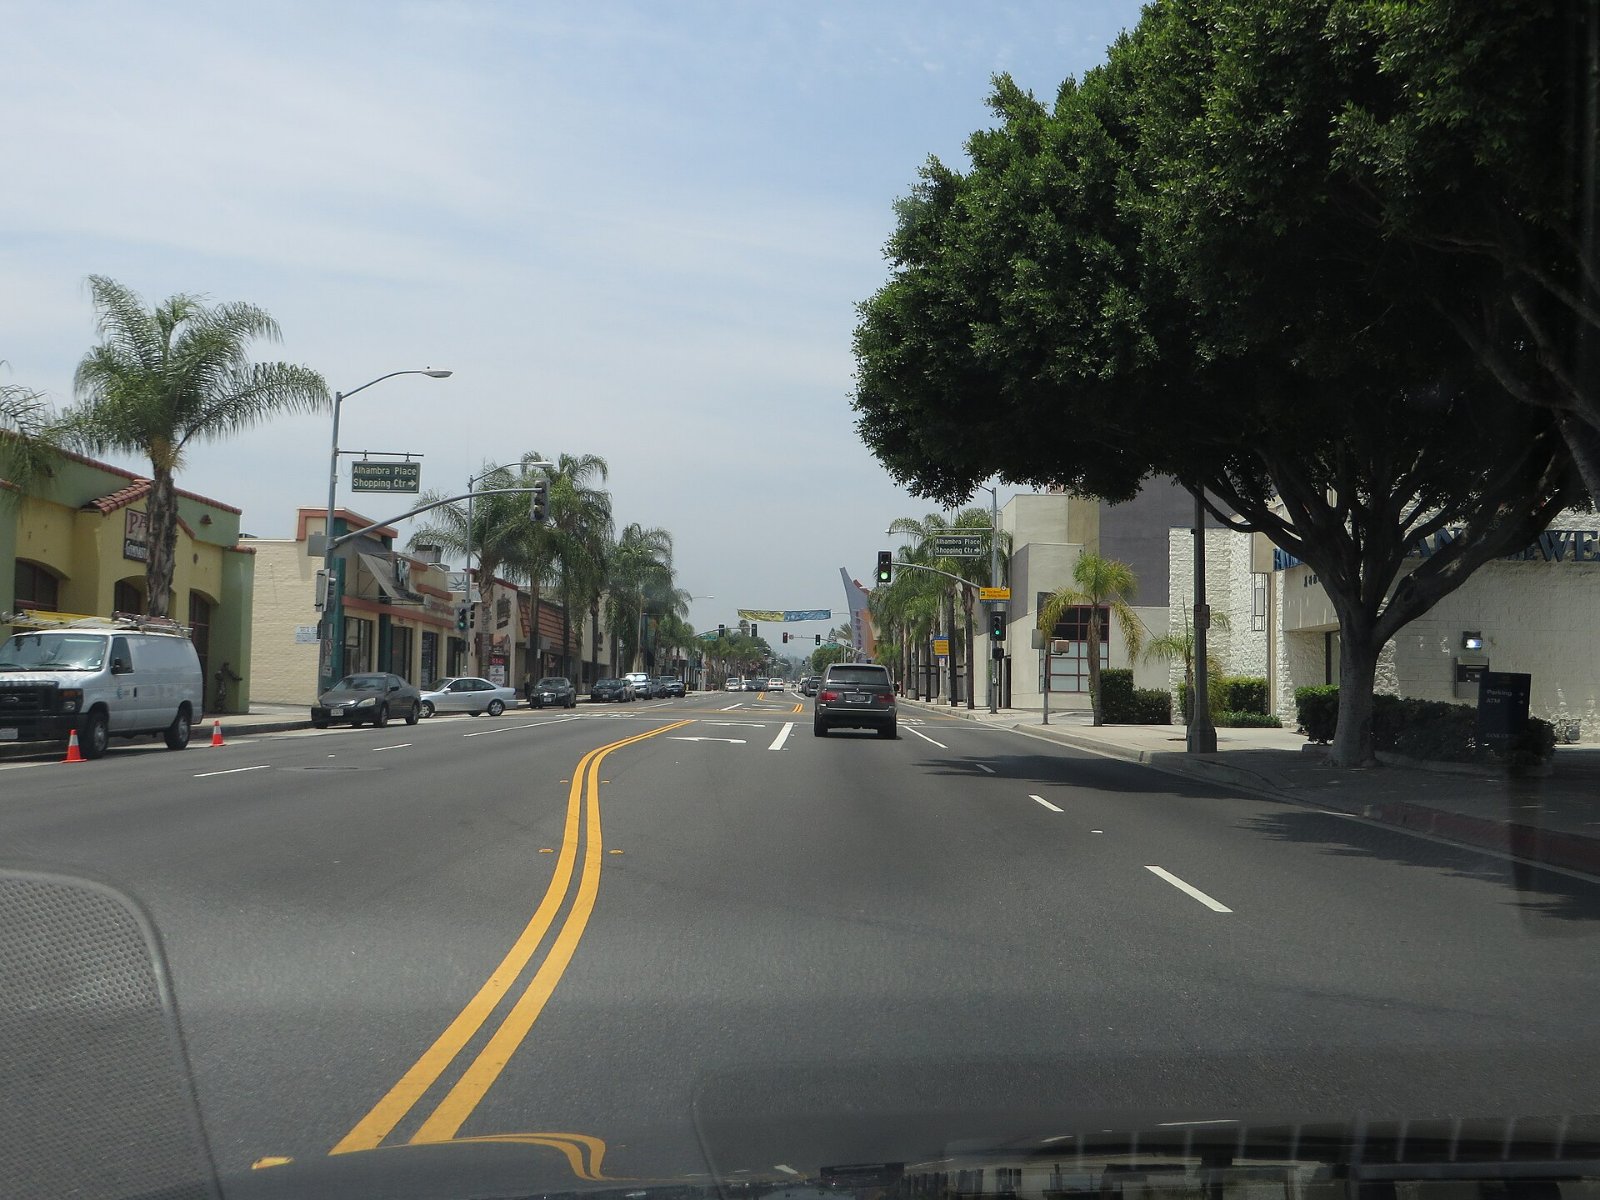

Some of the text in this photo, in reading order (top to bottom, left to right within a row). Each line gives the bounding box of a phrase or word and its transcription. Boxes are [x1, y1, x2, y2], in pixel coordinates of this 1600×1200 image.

[353, 466, 417, 476] Alhambra Place
[353, 478, 407, 490] Shopping Ctr
[936, 547, 963, 555] Shopping
[1486, 689, 1513, 697] Parking
